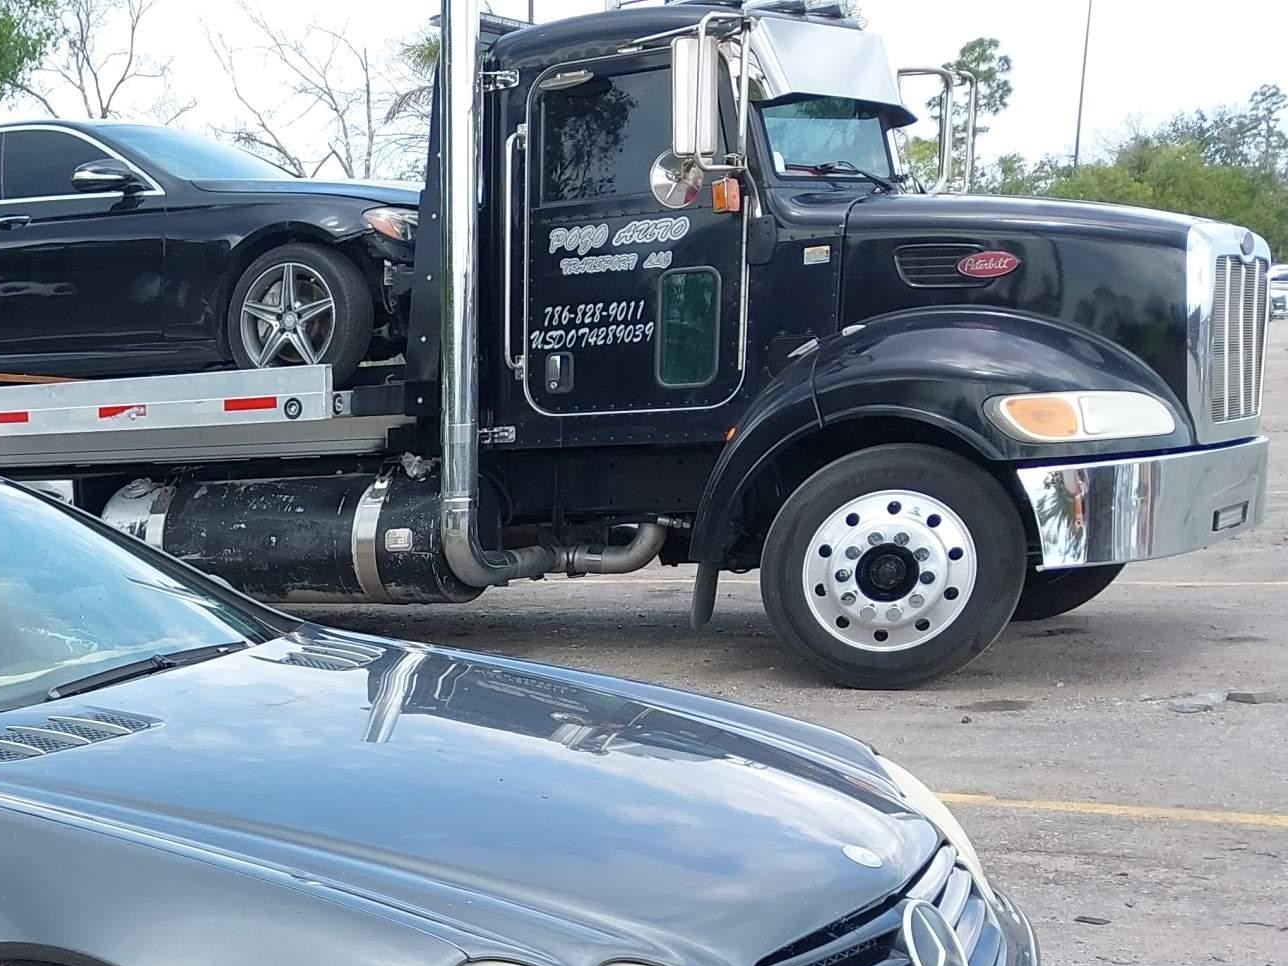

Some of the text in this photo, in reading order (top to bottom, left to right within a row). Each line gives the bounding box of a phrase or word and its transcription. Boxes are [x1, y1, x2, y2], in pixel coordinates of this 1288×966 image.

[612, 216, 690, 247] AUTO
[560, 253, 638, 275] TRANSPORT
[964, 257, 1013, 272] Peterbilt
[544, 299, 645, 327] 786-828-9011
